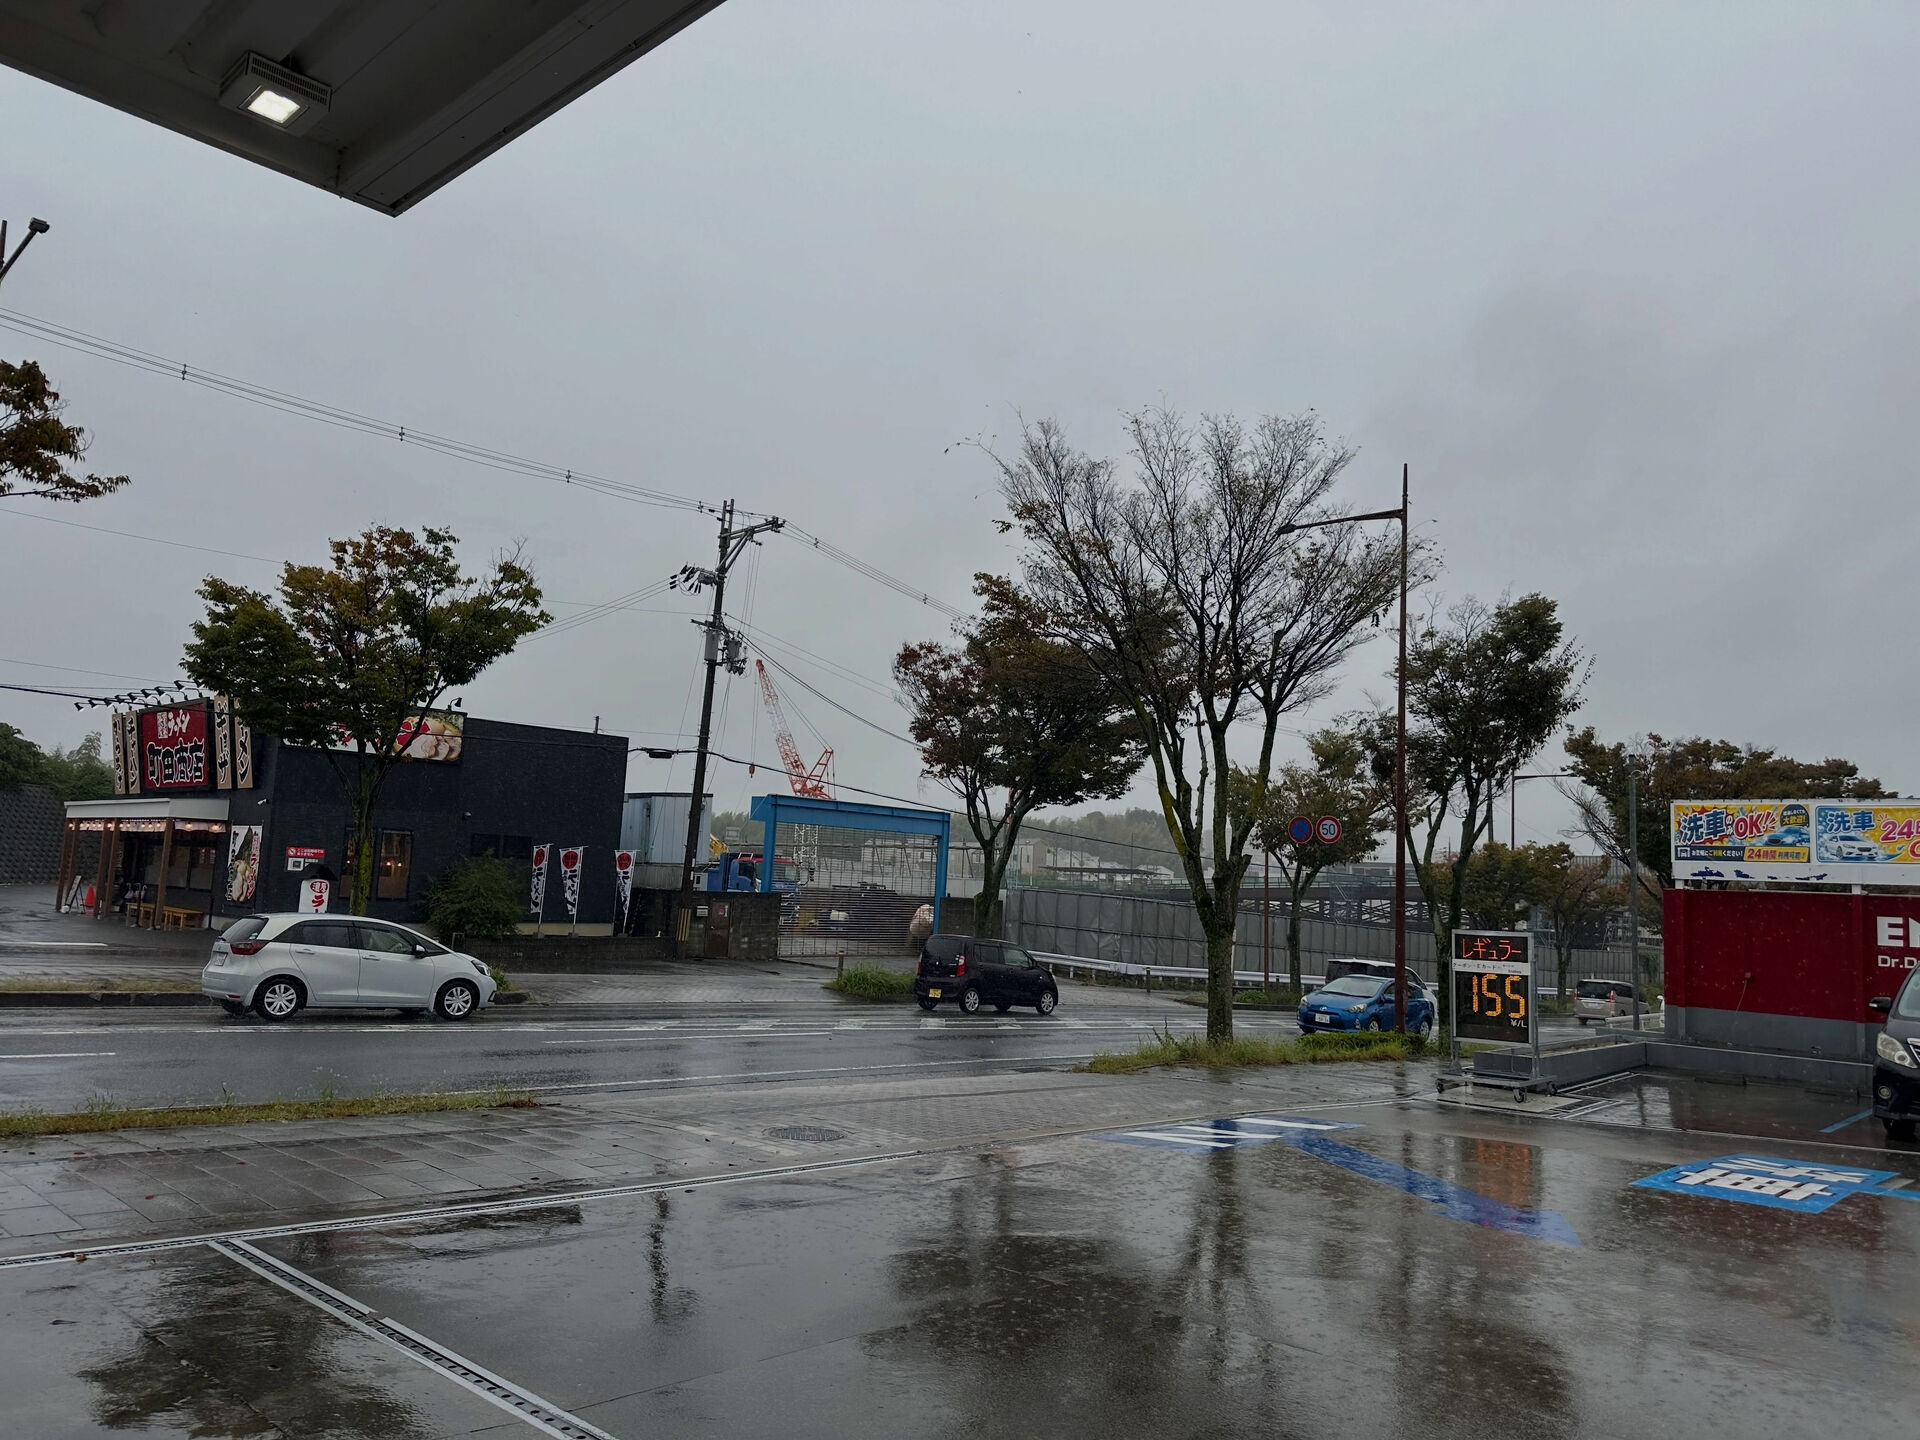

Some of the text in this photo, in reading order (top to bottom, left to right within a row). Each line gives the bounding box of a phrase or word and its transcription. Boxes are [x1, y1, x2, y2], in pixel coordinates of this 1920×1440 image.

[147, 737, 205, 787] 町田商店
[1321, 823, 1336, 836] 50
[1827, 810, 1875, 833] 洗車
[1461, 938, 1522, 960] レギュラー
[1877, 955, 1919, 969] Dr.D
[1471, 973, 1526, 1019] 155
